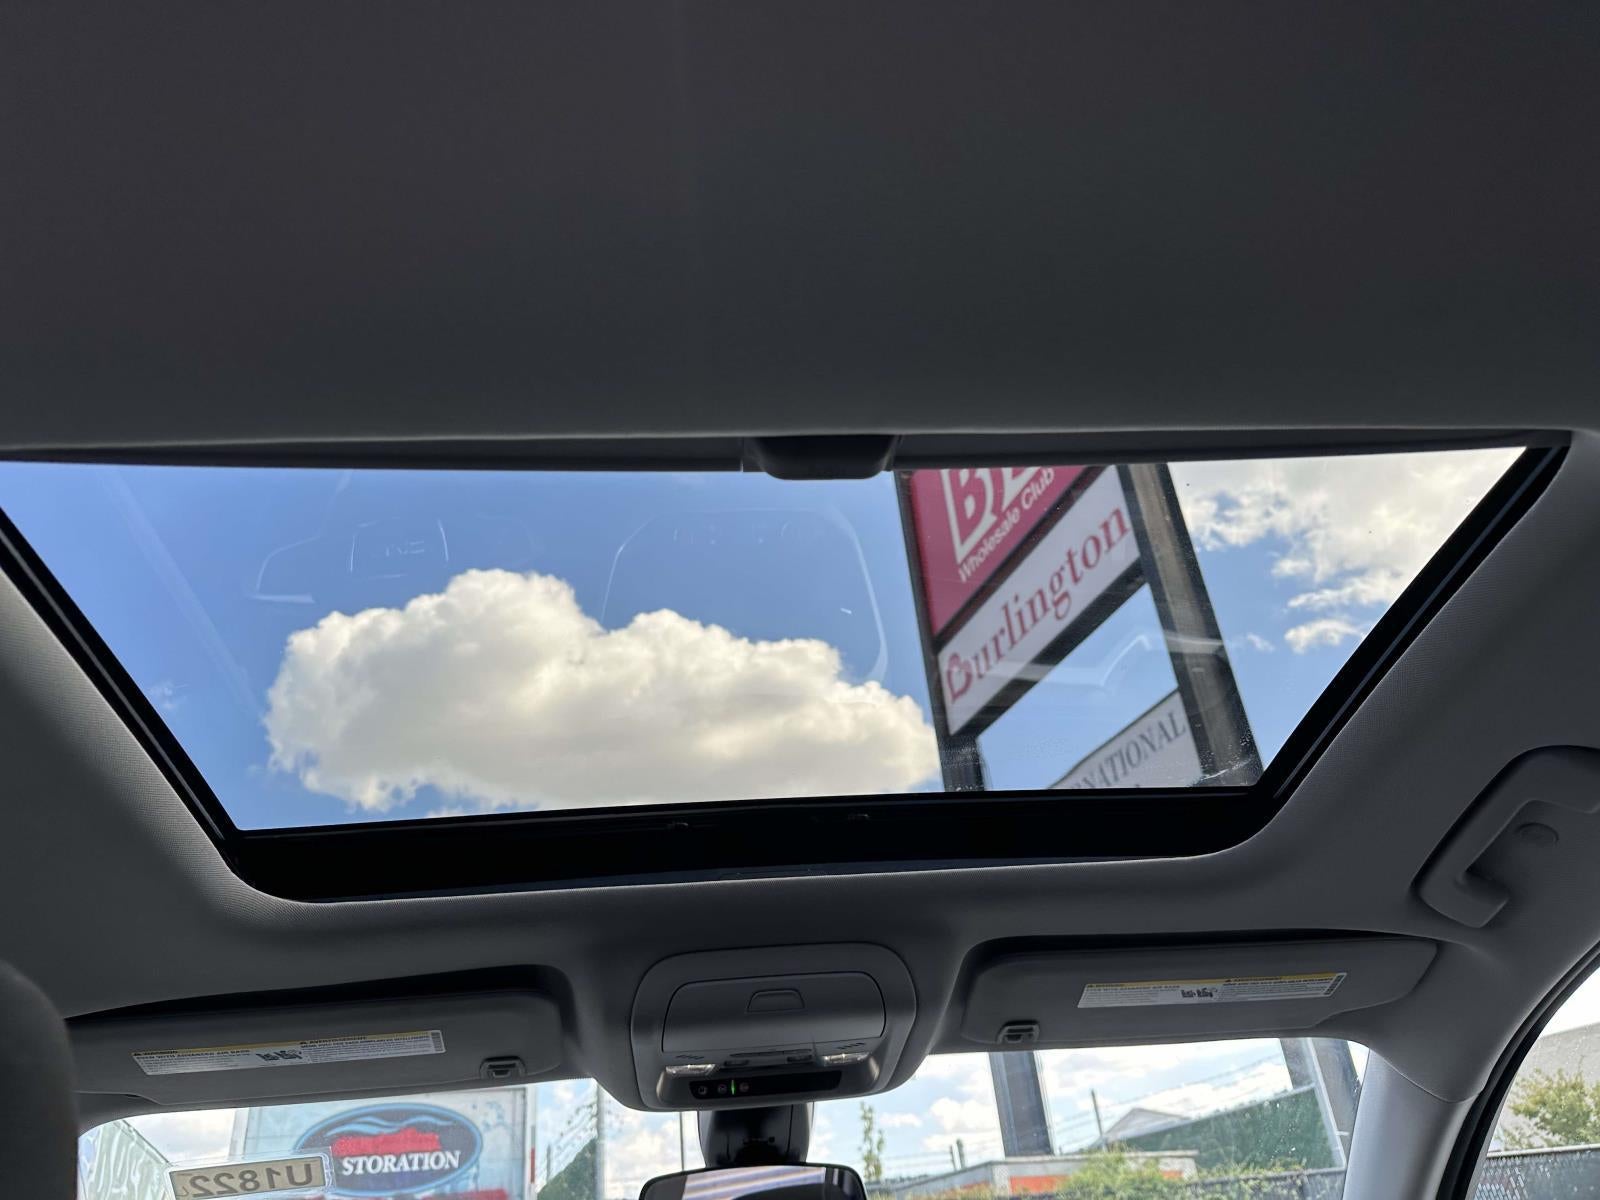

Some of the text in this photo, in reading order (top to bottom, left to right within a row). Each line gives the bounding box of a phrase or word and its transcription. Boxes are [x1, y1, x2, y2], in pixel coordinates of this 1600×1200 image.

[959, 467, 1055, 582] Wholesale Club
[944, 504, 1131, 700] Burlington
[342, 1150, 461, 1175] STORATION
